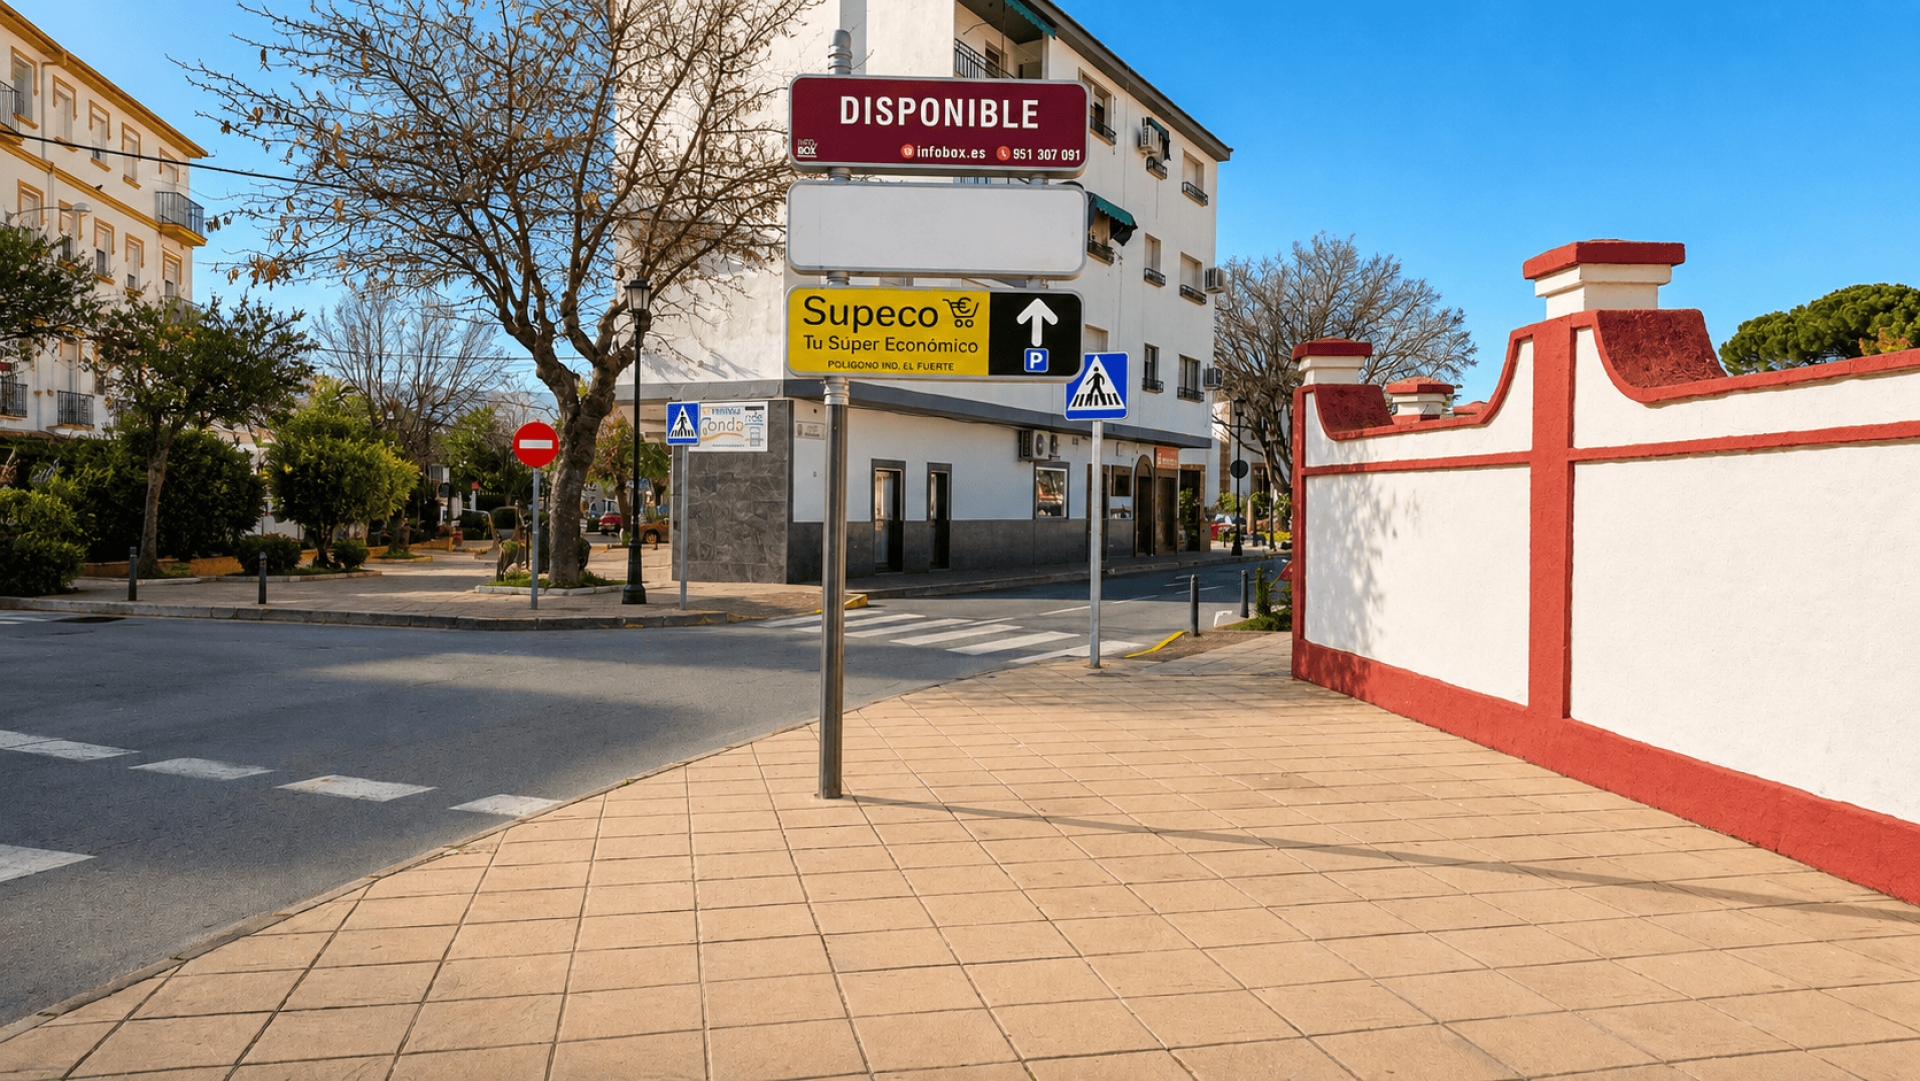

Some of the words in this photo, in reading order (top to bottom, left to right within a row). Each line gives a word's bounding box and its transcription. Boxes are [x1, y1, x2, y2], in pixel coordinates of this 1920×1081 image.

[840, 95, 1039, 129] DISPONIBLE
[917, 146, 986, 159] infobox.es
[1013, 148, 1033, 160] 951
[1037, 149, 1057, 161] 307
[1061, 149, 1081, 161] 091
[803, 296, 939, 334] Supeco
[803, 334, 823, 350] Tu
[828, 335, 880, 355] Súper
[885, 336, 979, 354] Económico
[827, 360, 879, 370] POLIGONO
[881, 361, 900, 371] IND.
[903, 362, 914, 371] EL
[917, 362, 954, 371] FUERTE
[1030, 352, 1042, 369] P
